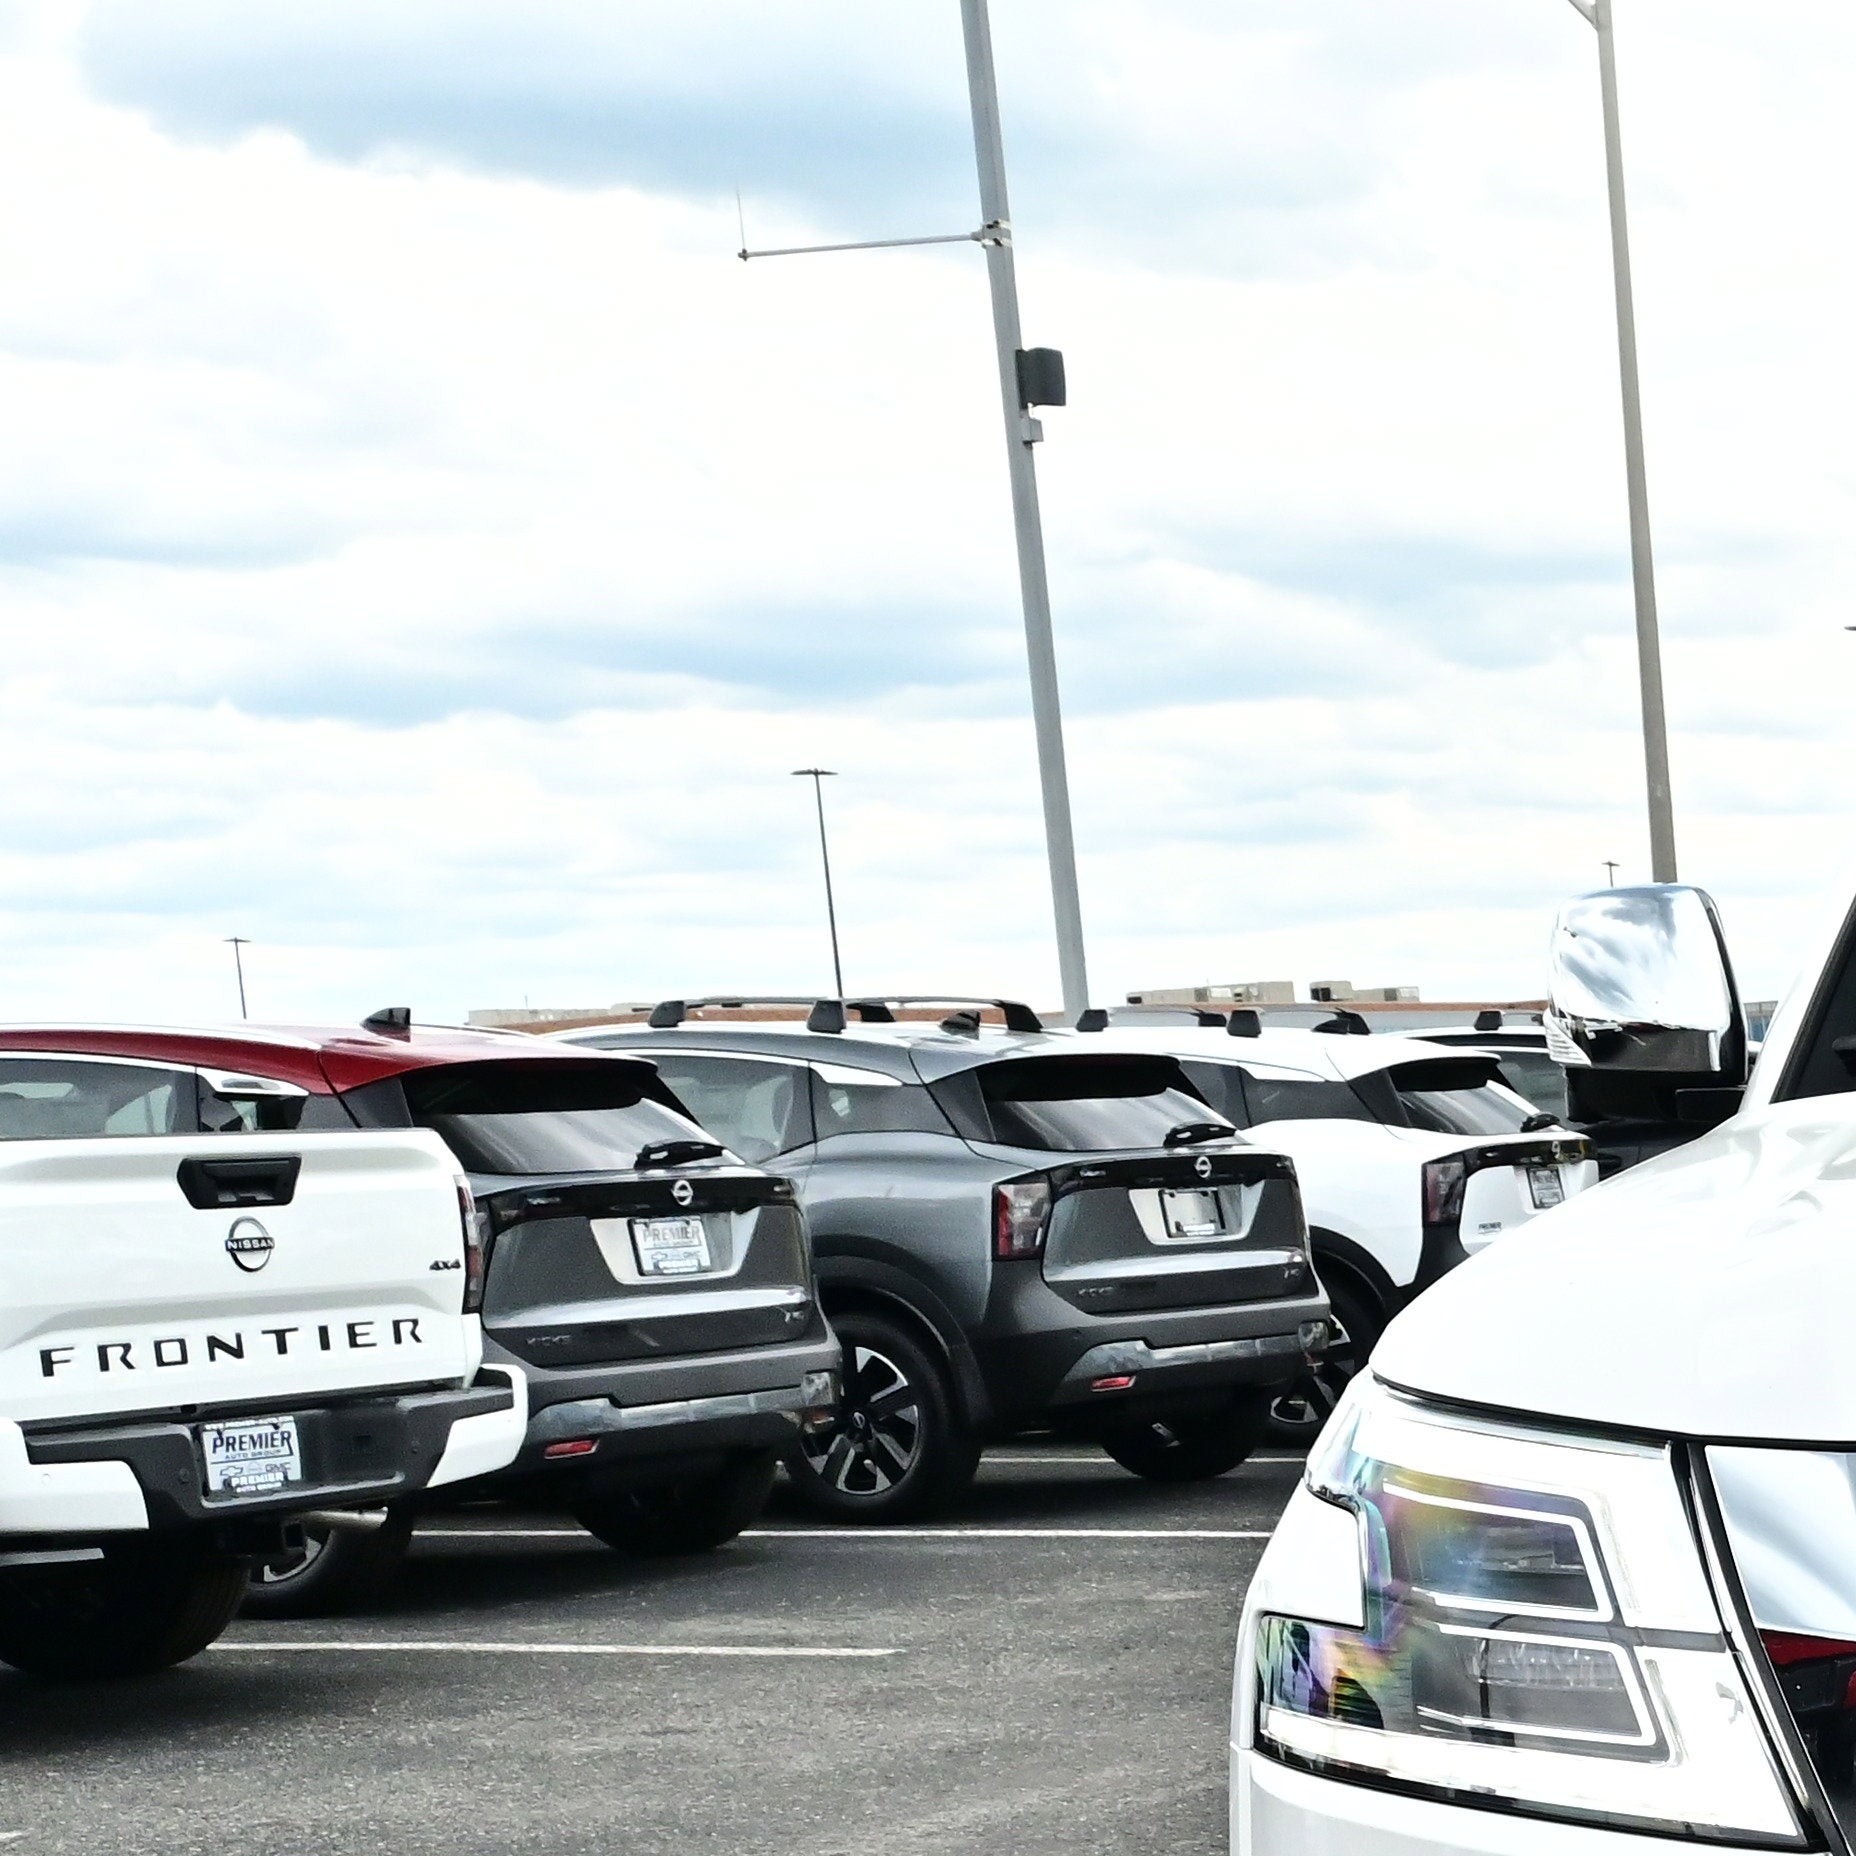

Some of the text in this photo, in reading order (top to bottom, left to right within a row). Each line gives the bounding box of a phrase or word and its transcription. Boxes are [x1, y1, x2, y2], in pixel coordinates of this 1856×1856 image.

[226, 1239, 274, 1250] NISSAN
[39, 1317, 424, 1378] FRONTIER
[212, 1430, 294, 1456] PREMIER
